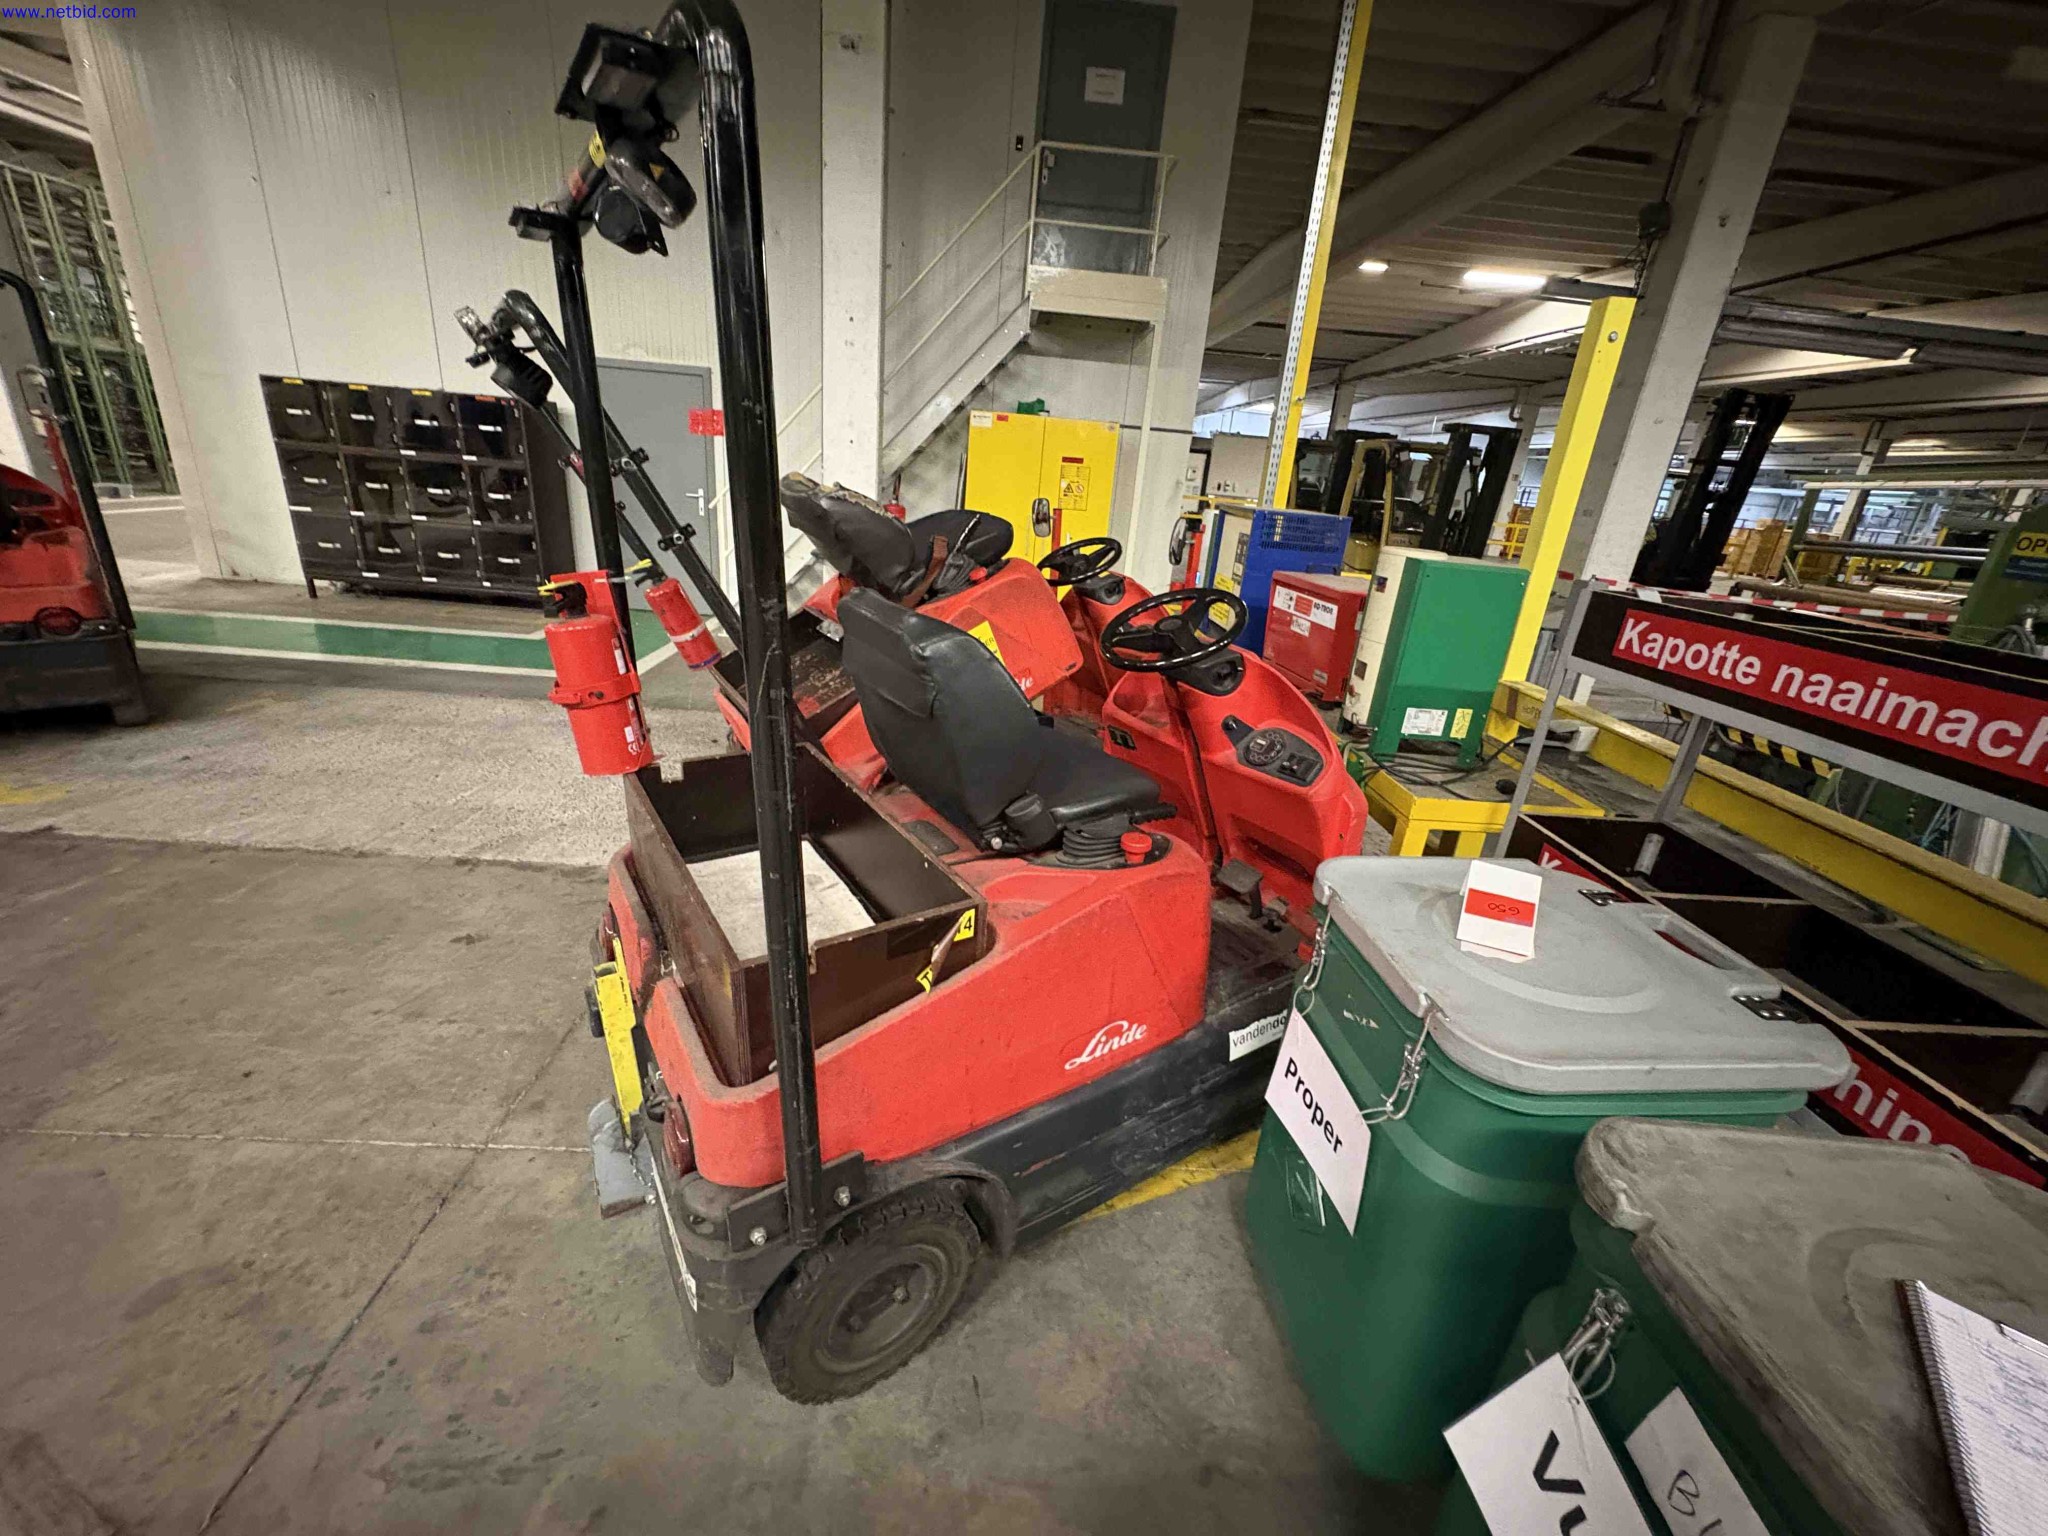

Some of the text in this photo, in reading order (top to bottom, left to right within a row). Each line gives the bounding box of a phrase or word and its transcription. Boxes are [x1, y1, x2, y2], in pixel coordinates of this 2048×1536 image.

[1619, 618, 1761, 685] Kapotte
[1064, 1020, 1147, 1070] Linde
[1284, 1056, 1343, 1154] Proper
